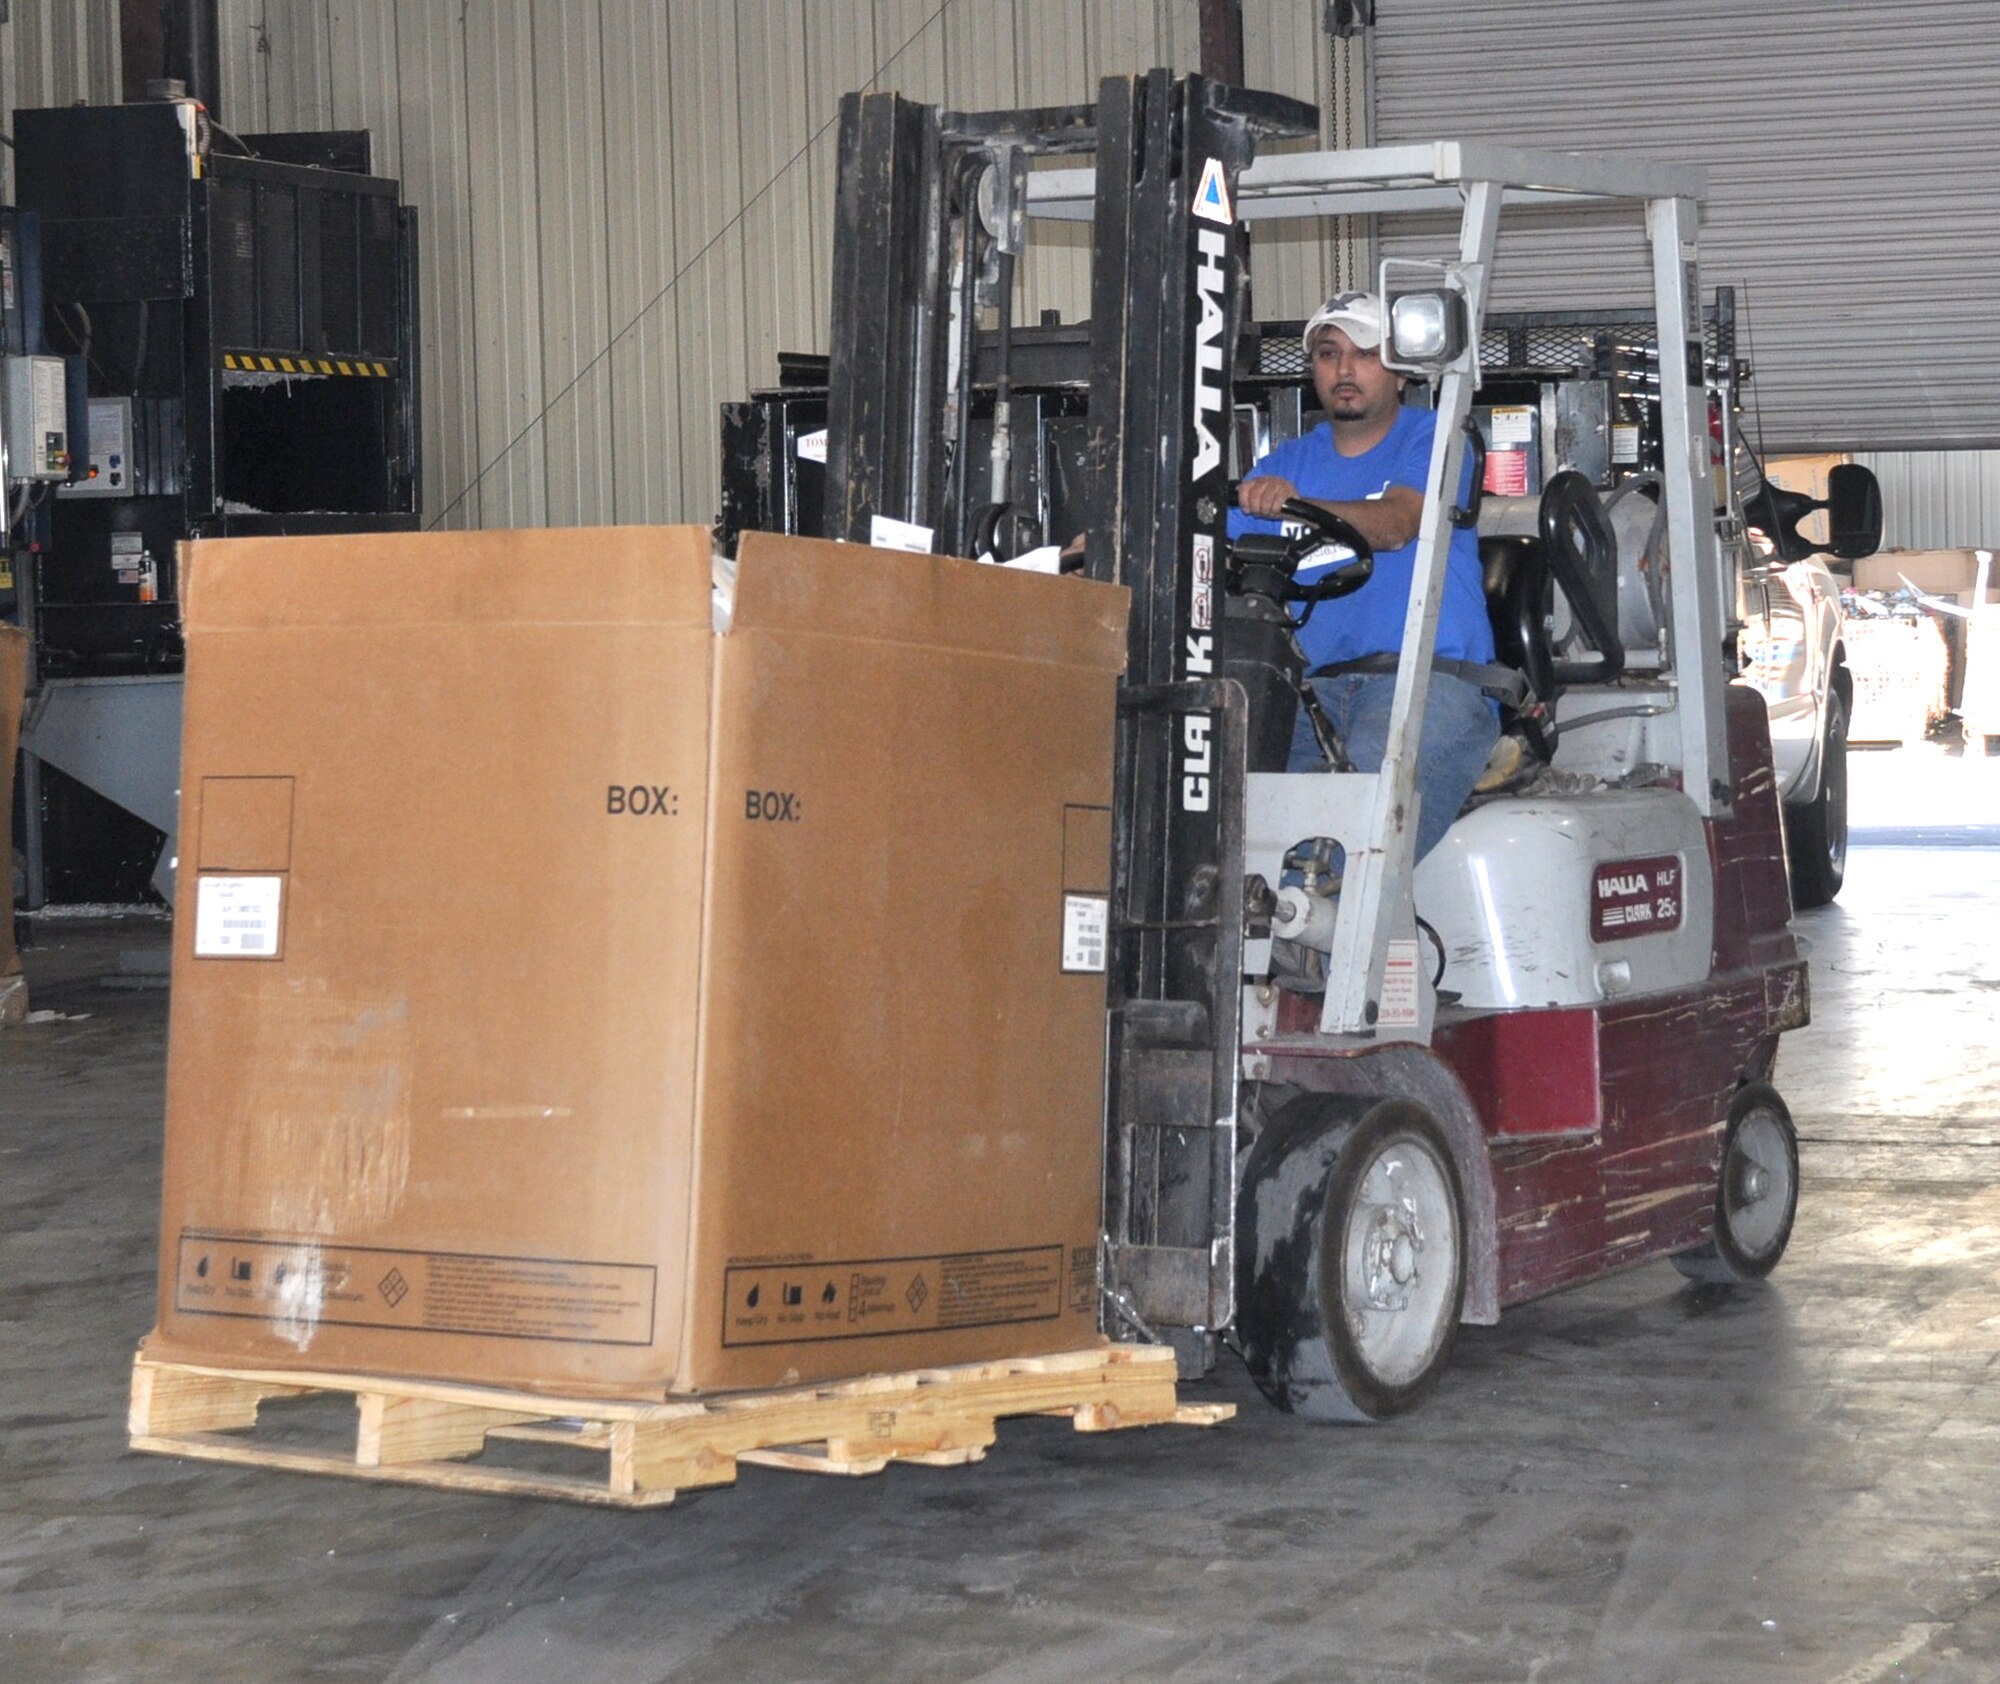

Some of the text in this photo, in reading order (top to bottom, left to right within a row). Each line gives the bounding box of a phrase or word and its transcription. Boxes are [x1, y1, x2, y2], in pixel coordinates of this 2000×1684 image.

[1192, 228, 1225, 482] HALLA
[1183, 635, 1213, 812] CLAK
[606, 786, 679, 816] BOX:
[745, 790, 802, 821] BOX:
[1598, 873, 1649, 899] HALLA
[1625, 903, 1652, 923] CLARK
